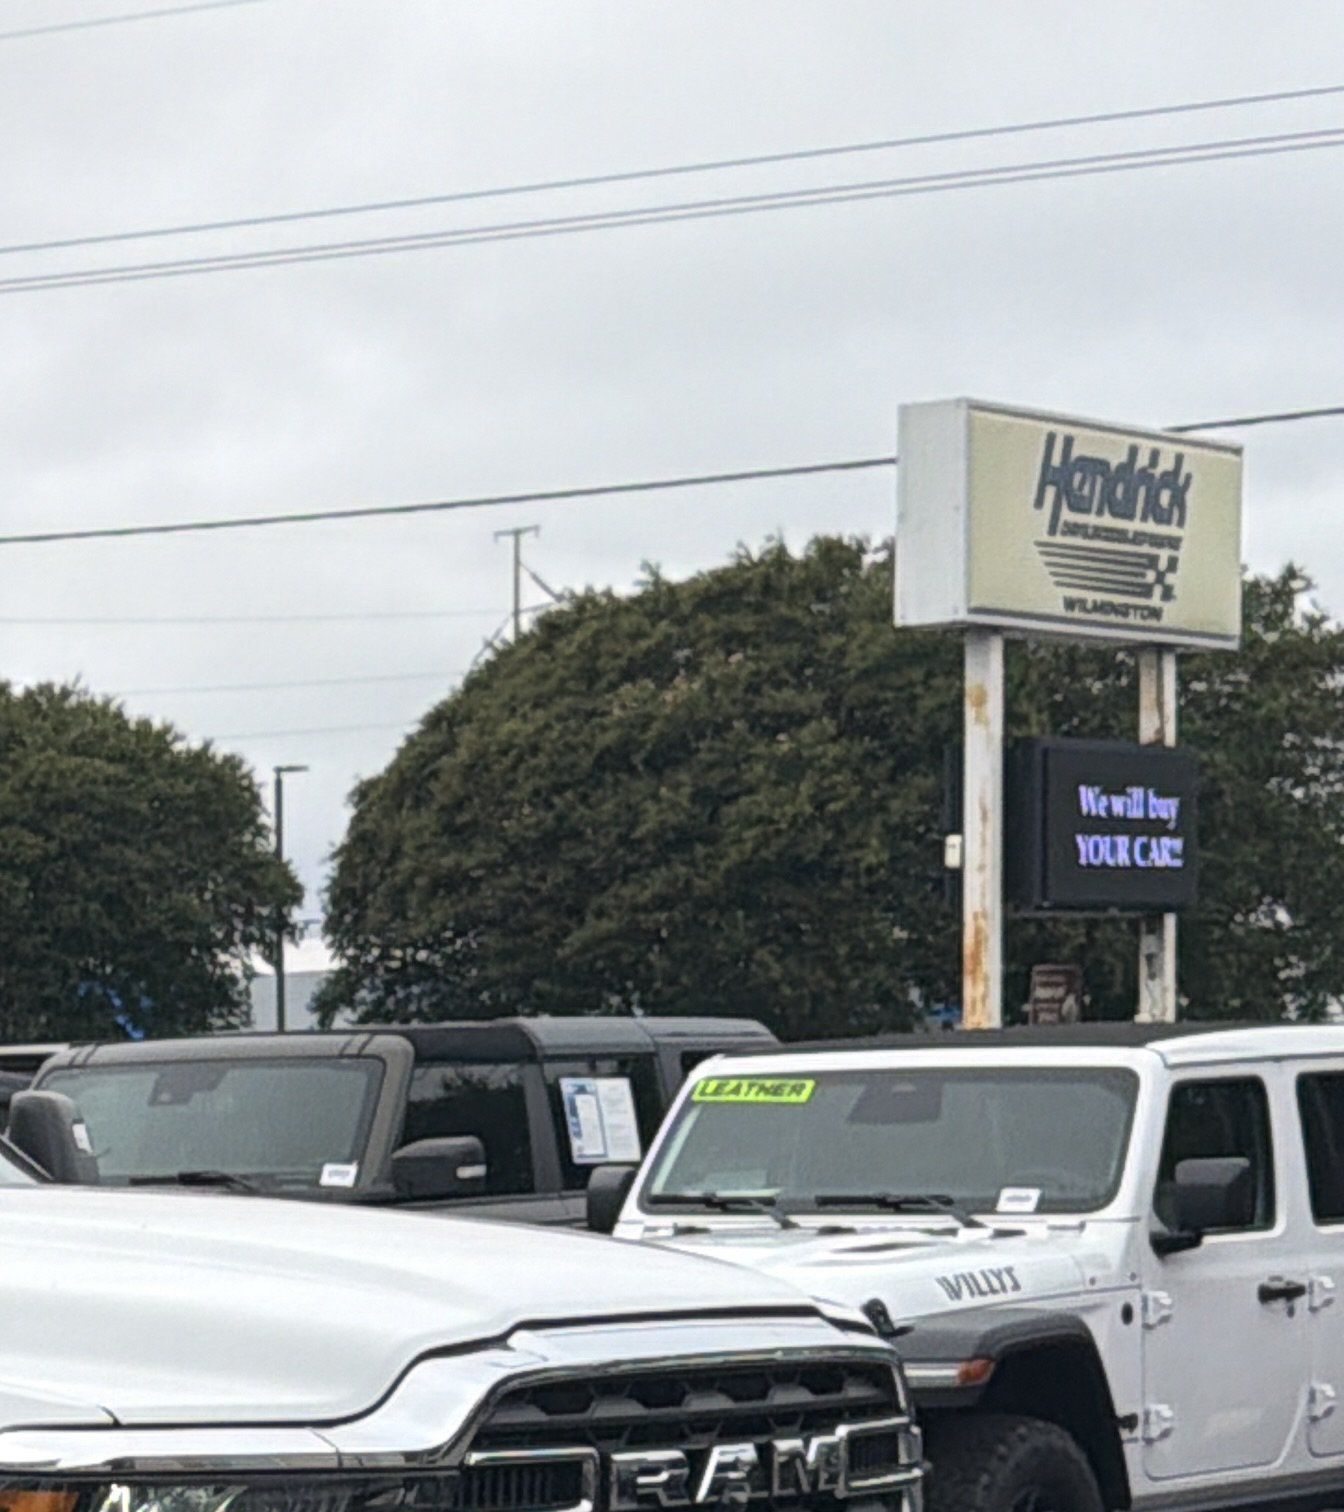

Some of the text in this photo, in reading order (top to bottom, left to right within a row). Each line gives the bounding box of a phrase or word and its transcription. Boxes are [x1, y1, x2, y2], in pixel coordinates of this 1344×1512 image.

[1033, 431, 1192, 536] Hendrick
[1078, 784, 1180, 830] We will buy
[1075, 833, 1131, 867] YOUR
[698, 1080, 807, 1098] LEATHER
[934, 1265, 1022, 1301] WILLYS
[609, 1437, 841, 1512] RAM
